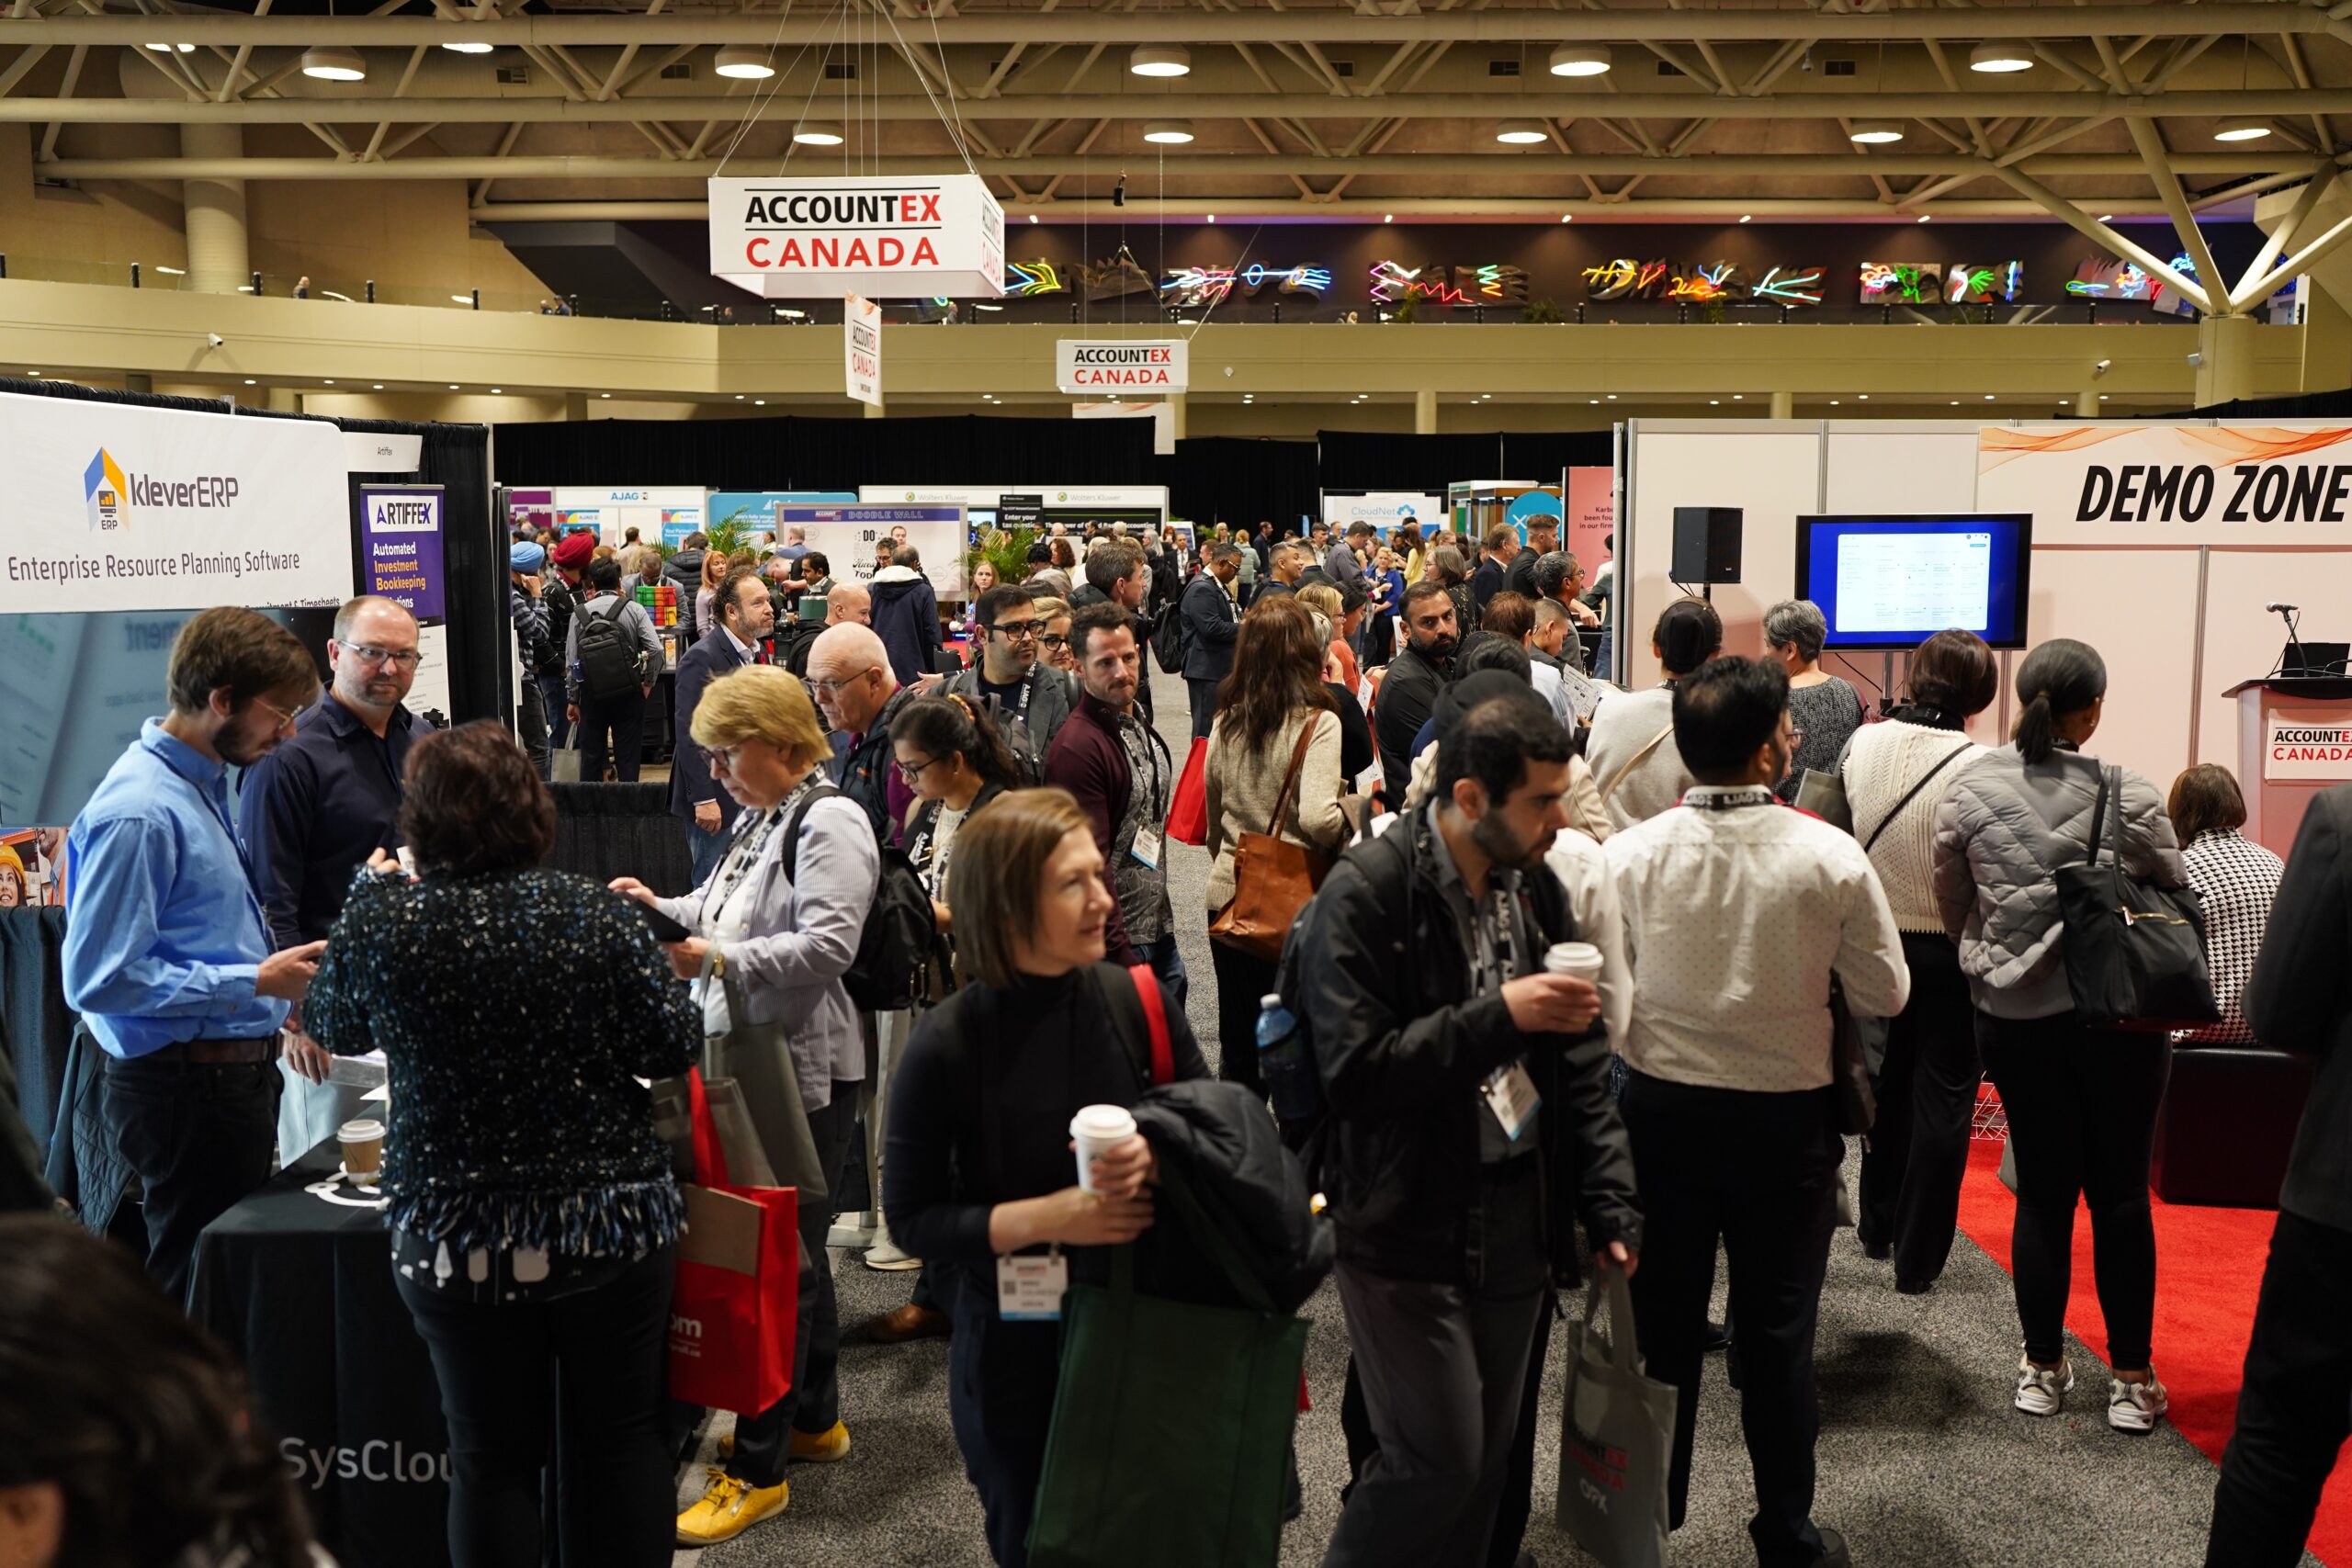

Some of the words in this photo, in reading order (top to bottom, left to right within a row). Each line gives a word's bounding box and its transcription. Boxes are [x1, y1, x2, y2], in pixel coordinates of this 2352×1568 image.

[745, 195, 941, 223] ACCOUNTEX
[746, 237, 939, 267] CANADA
[853, 325, 876, 352] ACCOUNTEX
[1075, 348, 1170, 363] ACCOUNTEX
[853, 353, 876, 379] CANADA
[1075, 369, 1169, 384] CANADA
[130, 473, 239, 508] kleverERP
[611, 492, 639, 501] AJAG
[1071, 493, 1096, 502] Wolters
[1099, 493, 1121, 502] Kluwer
[2075, 465, 2215, 523] DEMO
[2222, 465, 2352, 523] ZONE
[376, 502, 432, 525] ARTIFFEX
[849, 511, 891, 519] DOODLE
[894, 511, 923, 519] WALL
[1351, 507, 1396, 515] CloudNet
[101, 520, 118, 530] ERP
[863, 530, 875, 542] DO
[373, 541, 416, 557] Automated
[8, 553, 100, 585] Enterprise
[107, 554, 176, 578] Resource
[182, 551, 241, 579] Planning
[245, 550, 300, 570] Software
[374, 559, 419, 574] Investment
[376, 575, 426, 592] Bookkeeping
[2274, 730, 2352, 742] ACCOUNTE
[2273, 748, 2352, 761] CANADA
